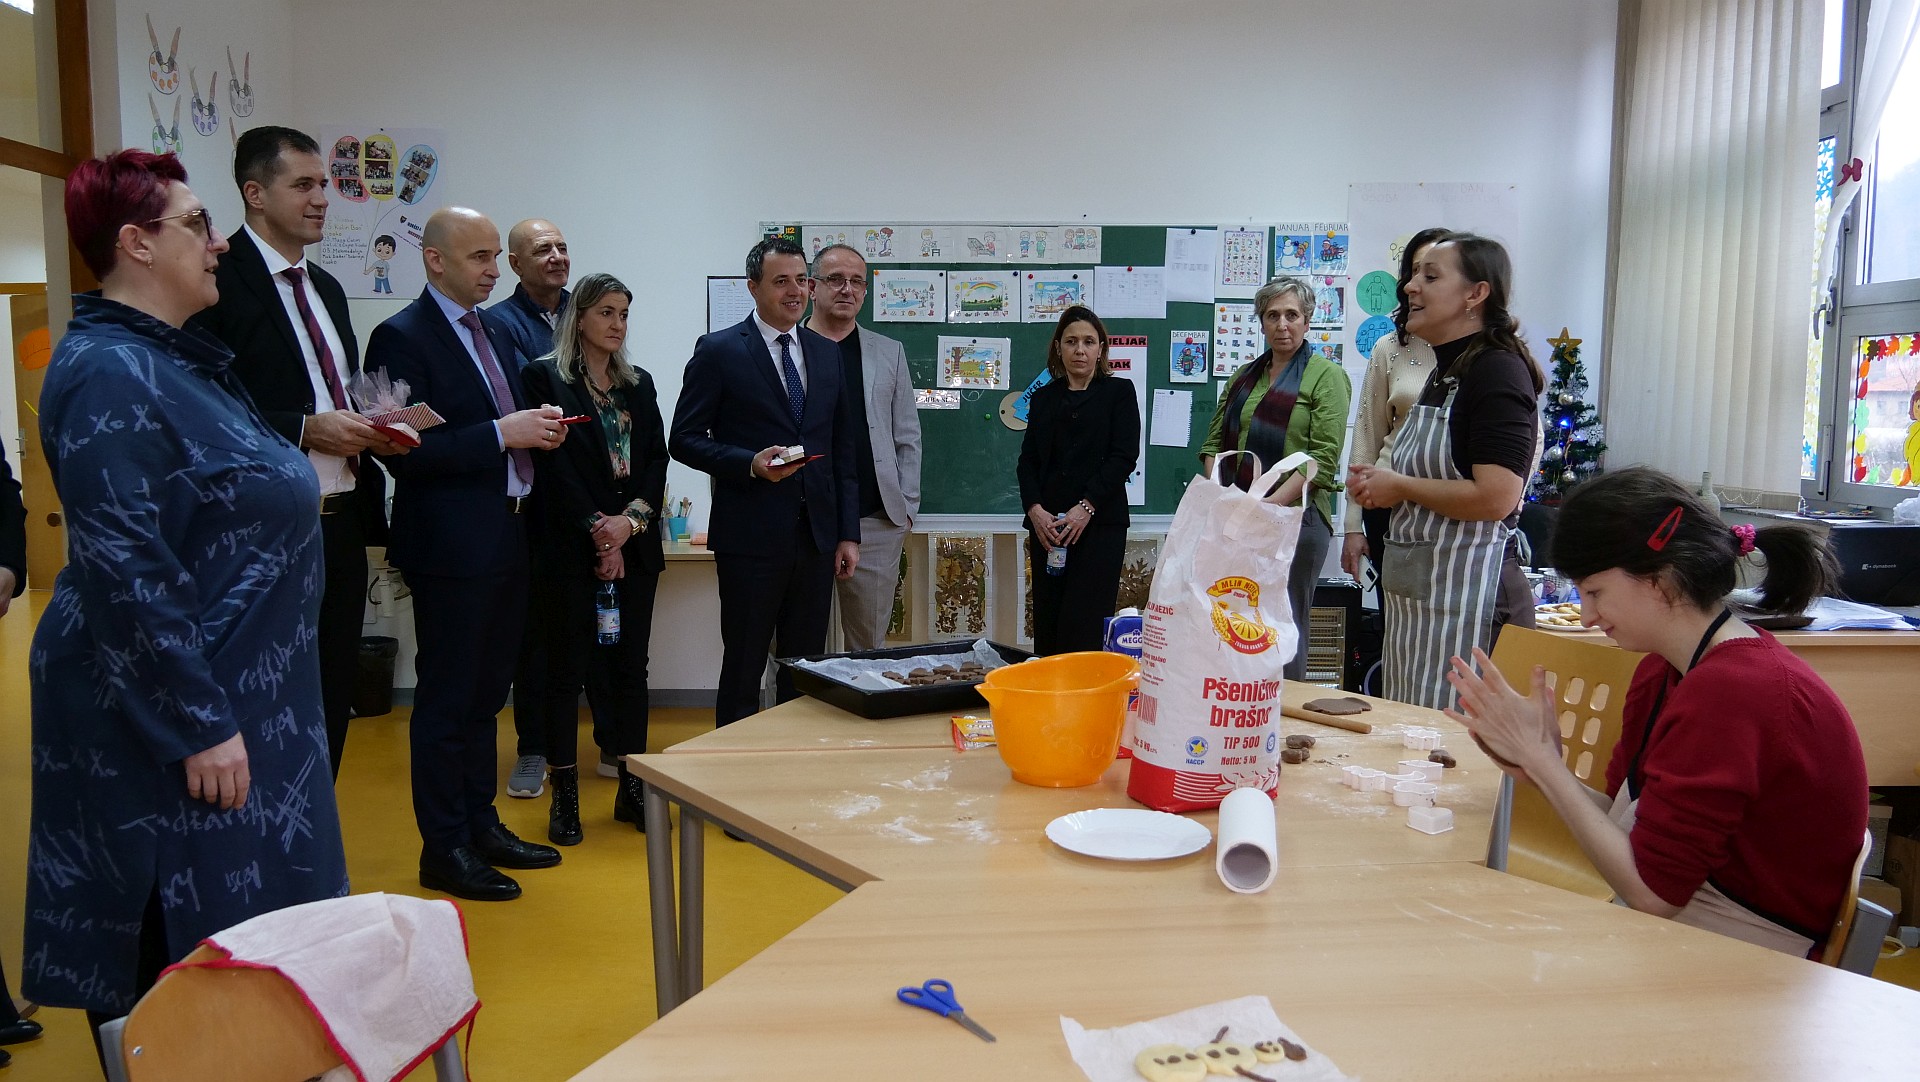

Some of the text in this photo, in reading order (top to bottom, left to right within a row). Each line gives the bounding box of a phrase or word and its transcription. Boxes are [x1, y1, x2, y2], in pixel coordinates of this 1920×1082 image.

[1277, 223, 1310, 232] JANUAR
[1314, 222, 1349, 232] FEBRUAR
[1172, 331, 1206, 339] DECEMBAR
[1022, 380, 1043, 403] JUČER
[1221, 579, 1243, 589] MLIN
[1202, 677, 1281, 702] Pšenično
[1209, 704, 1273, 728] brašno
[1223, 735, 1261, 750] TIP 500
[1185, 758, 1205, 766] HACCP
[1220, 755, 1257, 766] Netto: 5 kg
